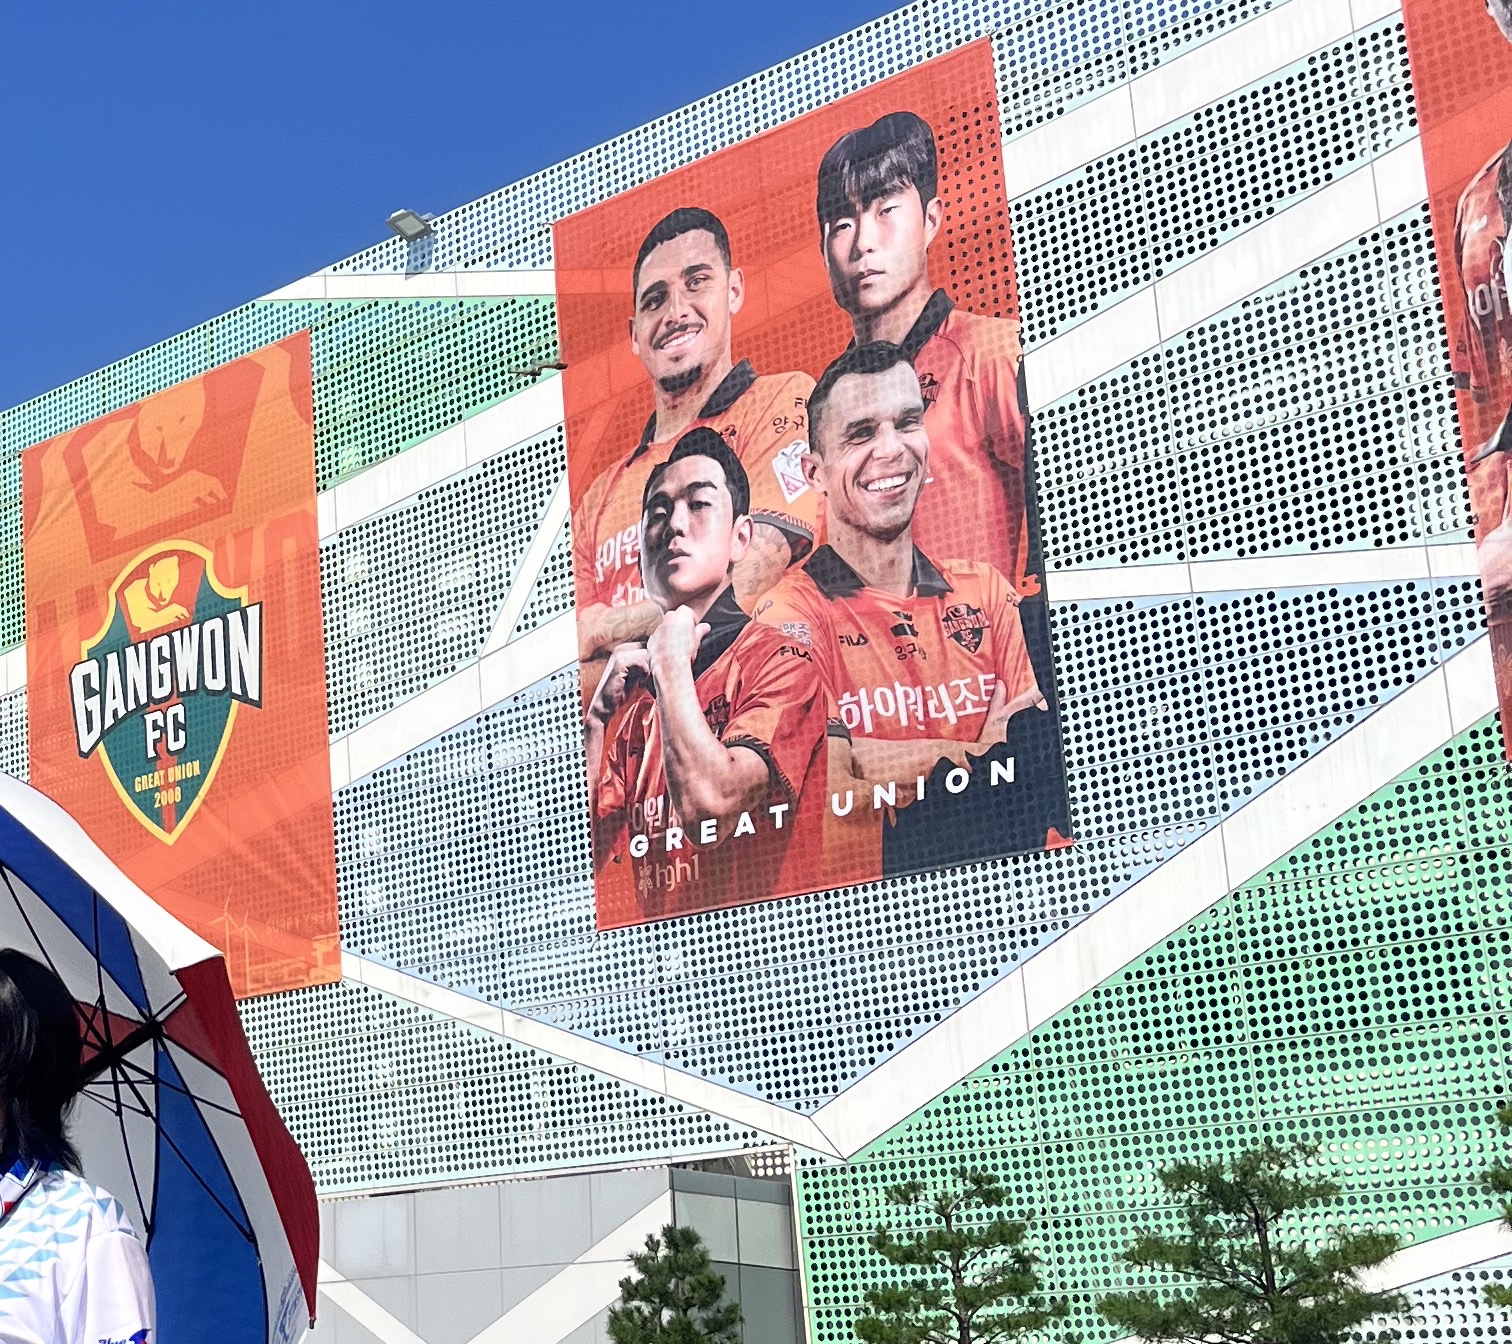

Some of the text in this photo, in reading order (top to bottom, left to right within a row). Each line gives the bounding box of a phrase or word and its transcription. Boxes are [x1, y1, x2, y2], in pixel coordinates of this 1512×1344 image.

[838, 632, 869, 647] FILA
[70, 602, 263, 758] GANGWON
[143, 703, 187, 760] FC
[134, 759, 201, 793] GREAT UNION
[153, 786, 183, 809] 2008
[629, 803, 789, 858] GREAT
[831, 756, 1015, 817] UNION
